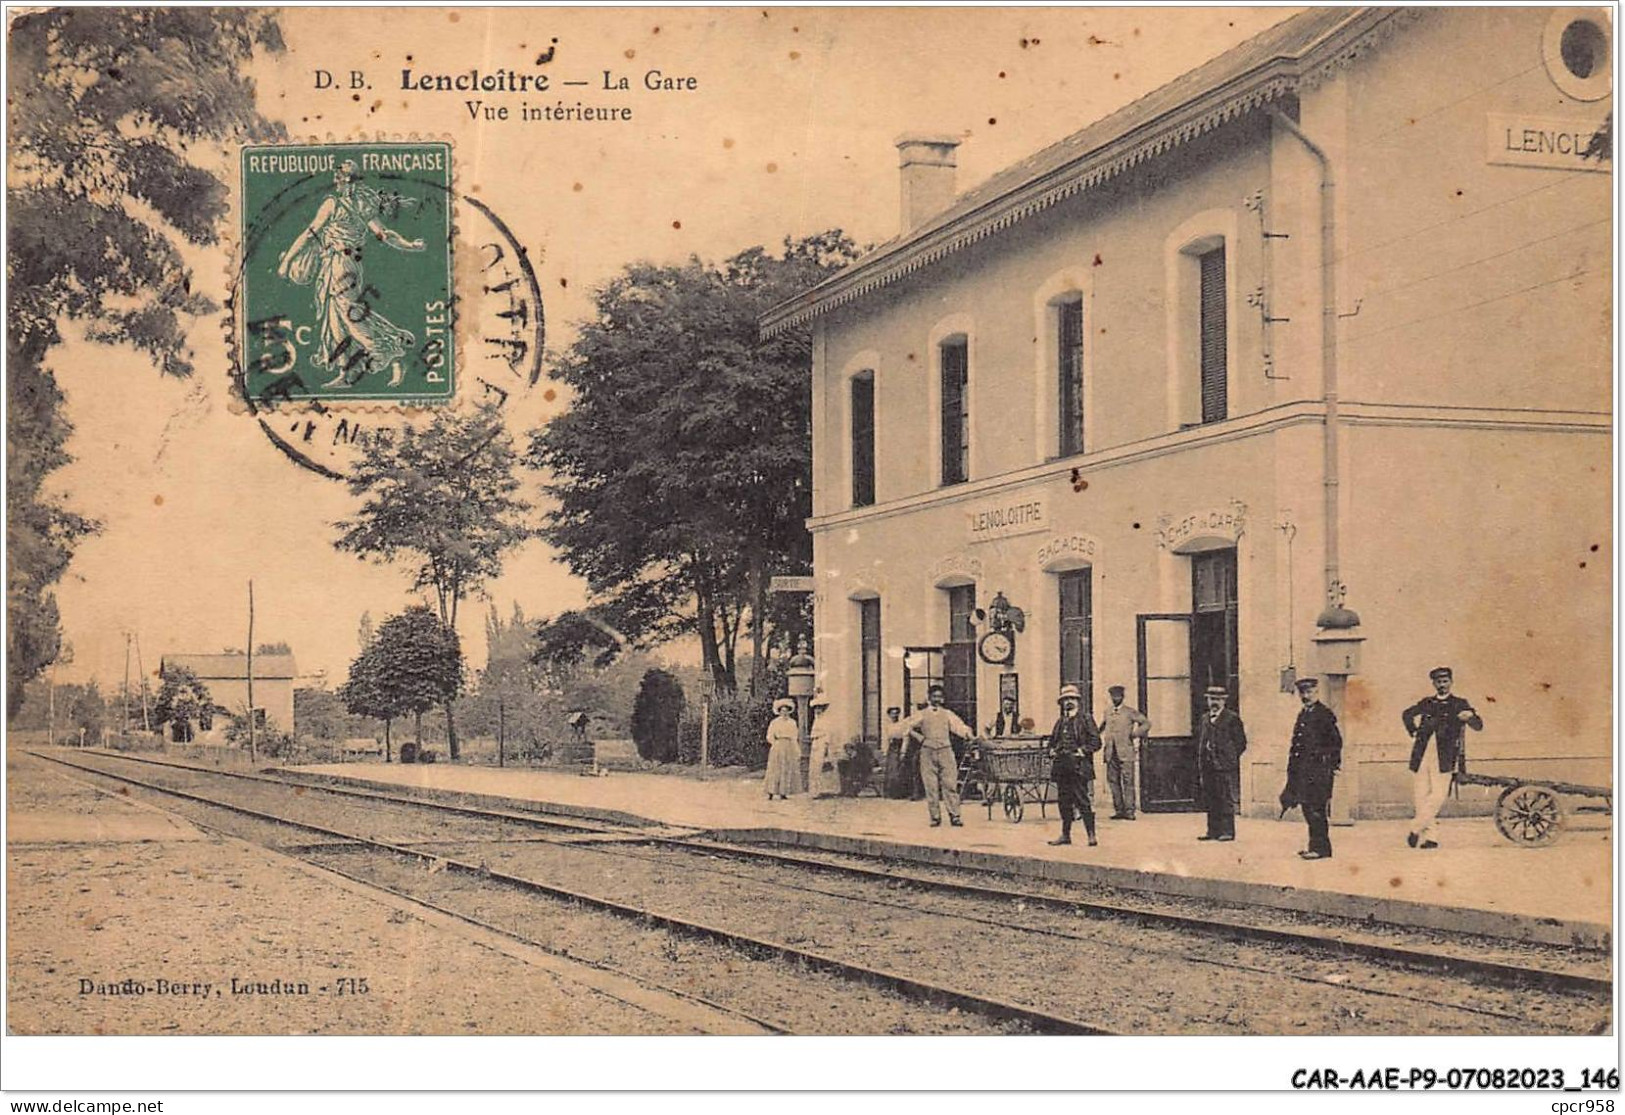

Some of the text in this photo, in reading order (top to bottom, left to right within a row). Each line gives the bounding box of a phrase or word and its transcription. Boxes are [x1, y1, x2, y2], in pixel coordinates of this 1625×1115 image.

[1506, 128, 1590, 158] LENCL
[362, 151, 444, 172] FRANÇAISE
[426, 299, 446, 384] POSTES
